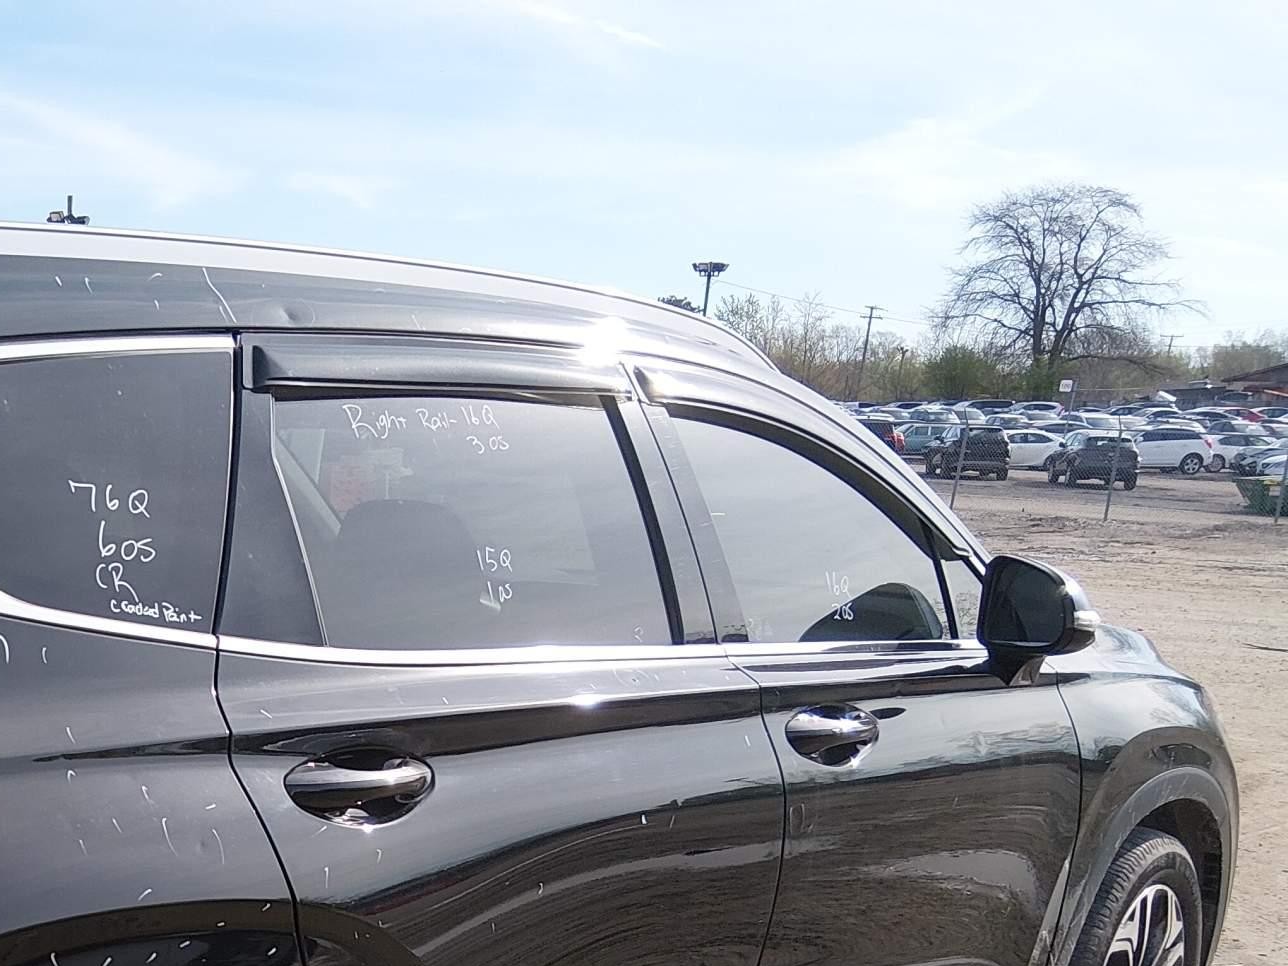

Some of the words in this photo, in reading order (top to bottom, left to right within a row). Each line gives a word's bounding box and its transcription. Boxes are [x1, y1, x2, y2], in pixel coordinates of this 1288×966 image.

[342, 404, 407, 438] Right
[68, 480, 150, 518] 76Q
[96, 562, 139, 602] CR
[162, 602, 202, 623] Paint
